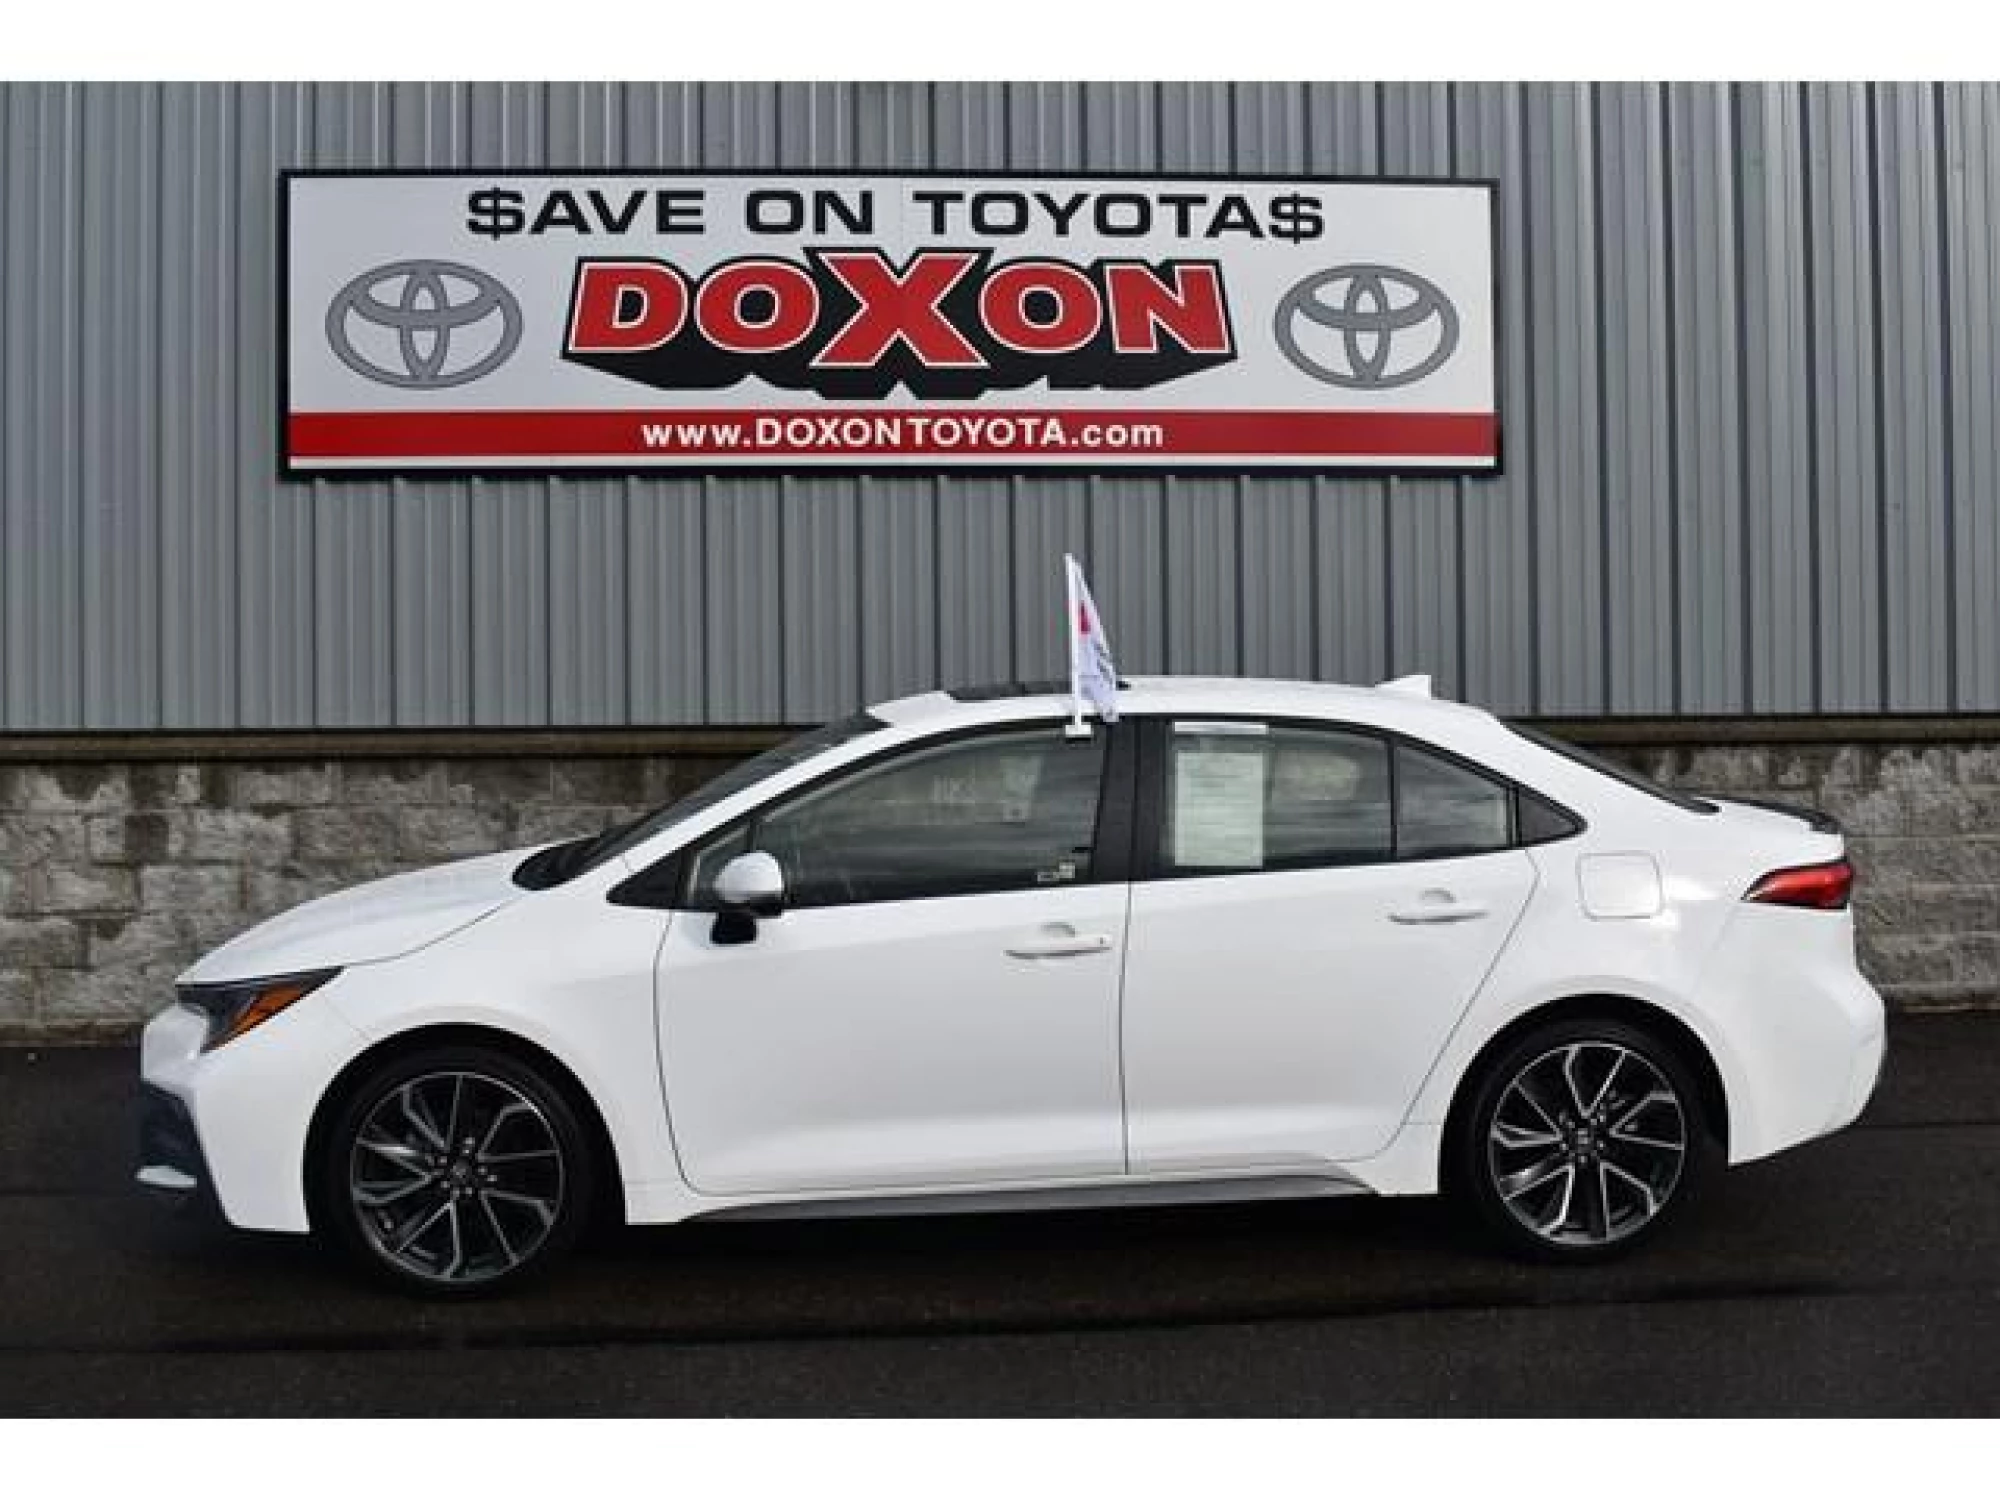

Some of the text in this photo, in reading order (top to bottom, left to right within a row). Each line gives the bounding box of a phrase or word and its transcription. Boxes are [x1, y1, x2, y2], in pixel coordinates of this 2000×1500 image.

[467, 186, 1324, 244] $AVE ON TOYOTA$
[564, 248, 1236, 372] DOXON
[641, 417, 1164, 448] www.DOXONTOYOTA.com
